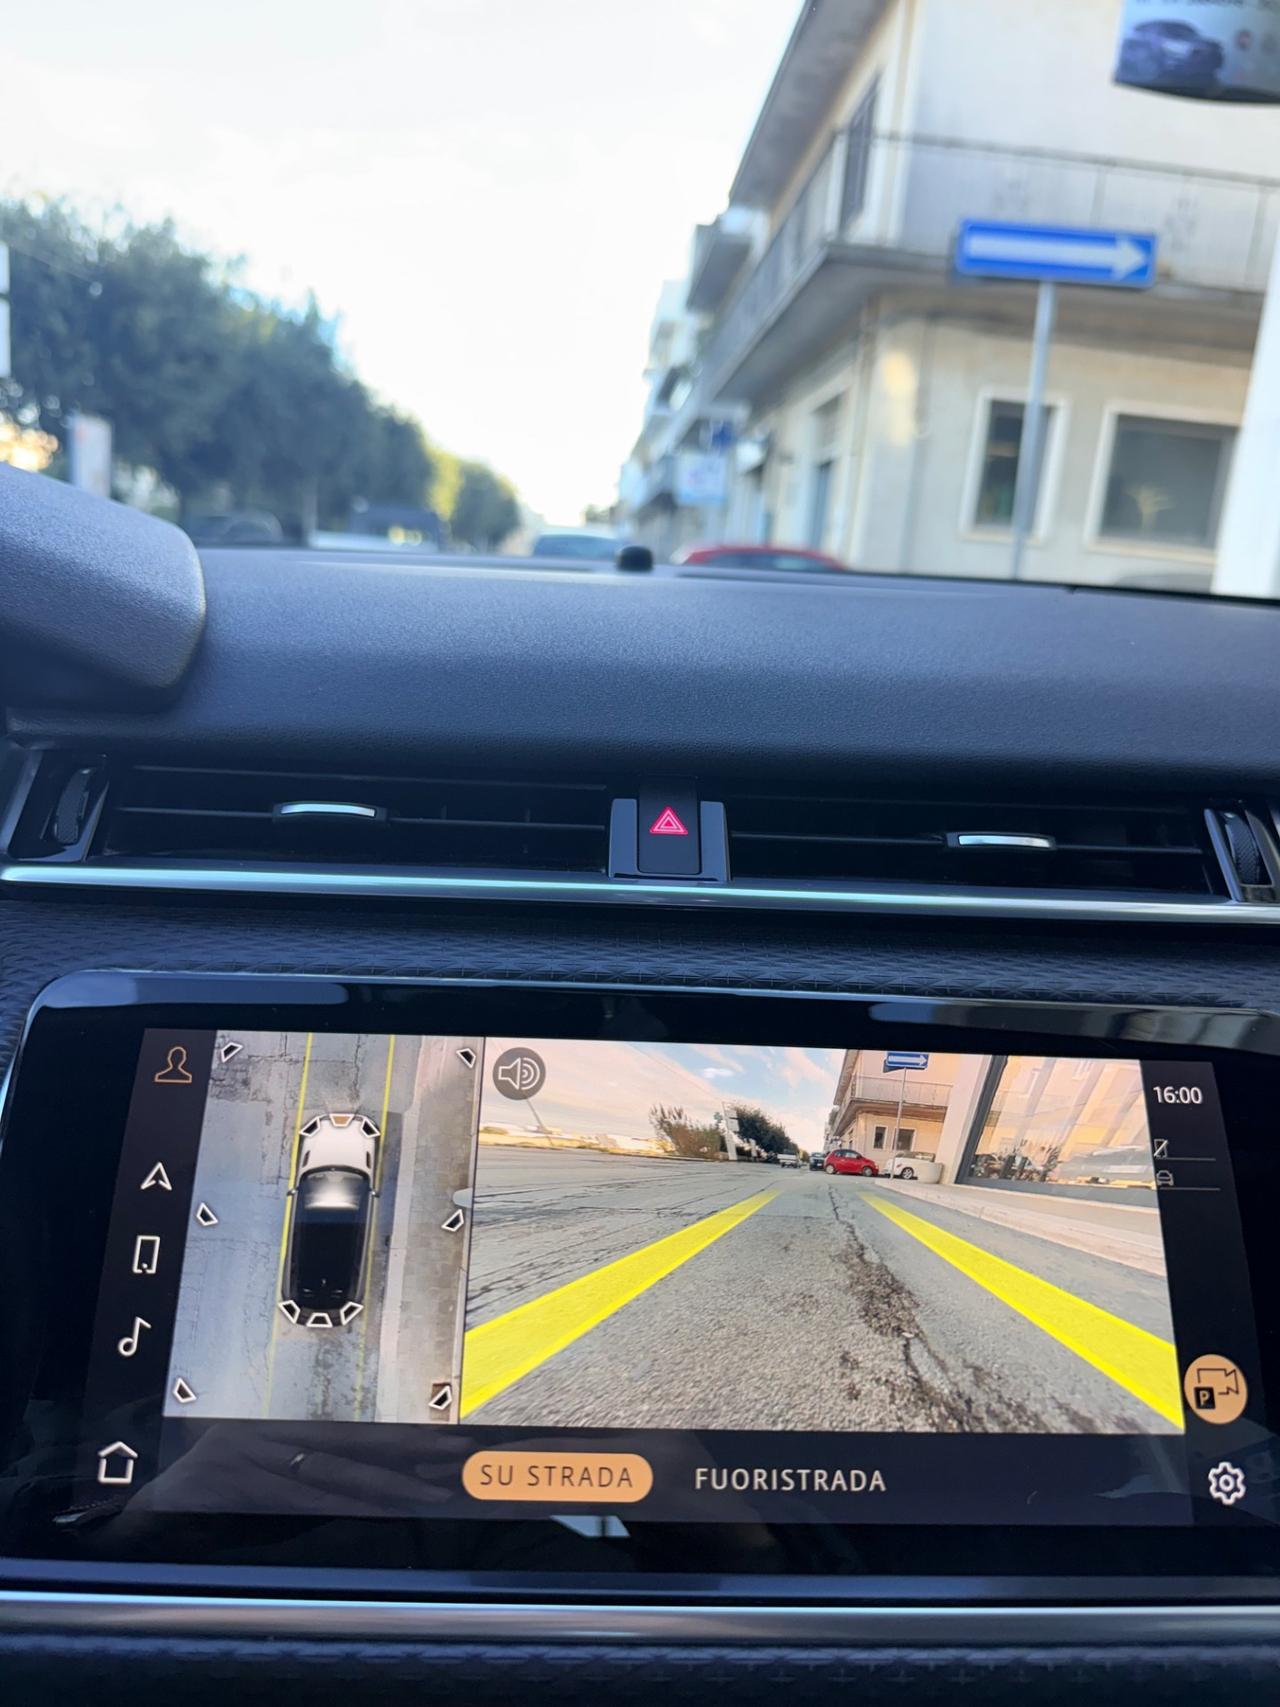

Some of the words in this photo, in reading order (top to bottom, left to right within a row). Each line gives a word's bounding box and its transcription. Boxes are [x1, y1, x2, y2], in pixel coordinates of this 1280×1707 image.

[1153, 1086, 1203, 1105] 16:00
[1199, 1390, 1210, 1406] P
[480, 1464, 514, 1486] SU
[527, 1465, 633, 1488] STRADA
[695, 1468, 886, 1492] FUORISTRADA
